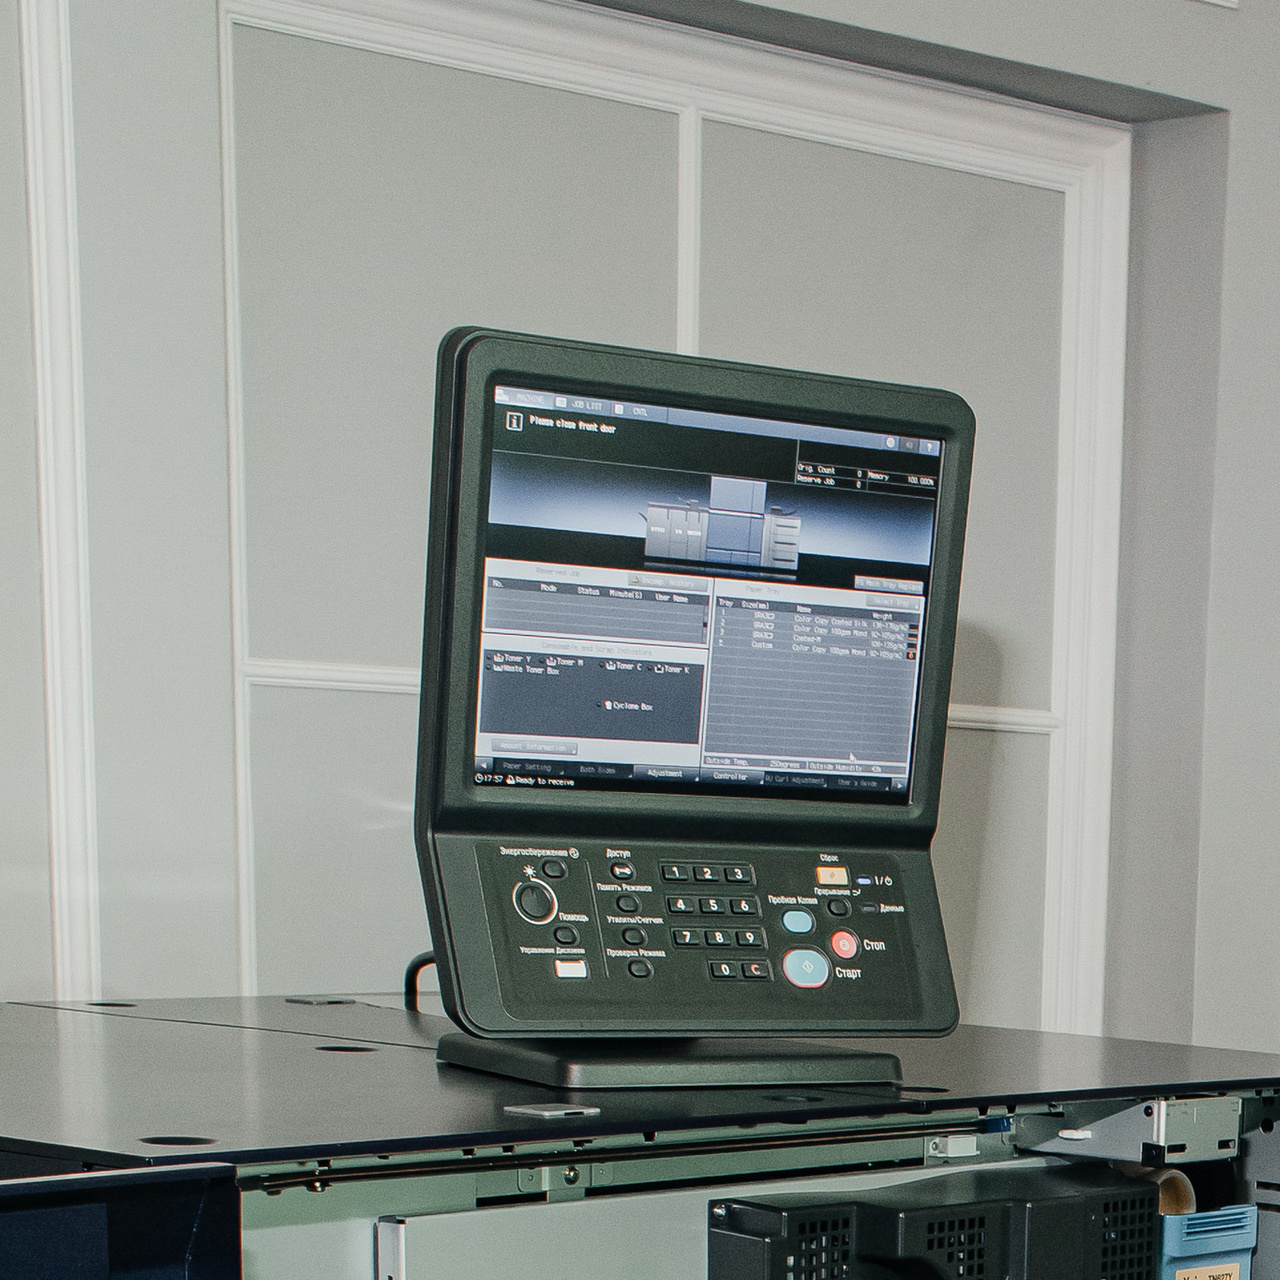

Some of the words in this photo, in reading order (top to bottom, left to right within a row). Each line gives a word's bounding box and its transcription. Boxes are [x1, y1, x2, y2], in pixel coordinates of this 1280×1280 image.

[572, 400, 584, 409] JOB
[586, 402, 602, 411] LIST
[529, 414, 554, 427] Please
[555, 418, 577, 430] close
[578, 420, 599, 432] front
[600, 423, 617, 434] door
[798, 463, 814, 473] Orig.
[817, 465, 835, 475] Count
[867, 469, 889, 481] Memory
[796, 473, 821, 484] Reserve
[823, 477, 836, 486] Job
[540, 583, 557, 592] Mode
[577, 586, 600, 596] Status
[609, 589, 643, 600] Minute(S)
[655, 593, 671, 602] User
[673, 594, 689, 603] Name
[718, 598, 734, 608] Tray
[796, 605, 812, 614] Name
[872, 612, 893, 621] Weight
[794, 615, 812, 623] Color
[814, 617, 829, 626] Copy
[793, 624, 812, 632] Color
[814, 626, 828, 635] Copy
[752, 641, 773, 649] Custom
[792, 644, 810, 652] Color
[812, 645, 827, 654] Copy
[504, 653, 524, 663] Toner
[556, 657, 576, 667] Toner
[616, 661, 635, 671] Toner
[664, 664, 683, 673] Toner
[526, 666, 545, 675] Toner
[547, 667, 560, 675] Box
[613, 701, 640, 711] Cyclone
[641, 702, 654, 711] Box
[647, 769, 683, 779] Adjustment
[713, 771, 749, 782] Controller
[484, 774, 503, 783] 17:57
[515, 775, 536, 786] Ready
[537, 777, 546, 786] to
[547, 778, 575, 787] receive
[606, 848, 631, 858] Доступ
[820, 853, 839, 862] Сброс
[672, 866, 679, 878] 1
[703, 867, 712, 879] 2
[734, 868, 743, 880] 3
[676, 899, 685, 911] 4
[709, 899, 718, 911] 5
[740, 900, 749, 911] 6
[768, 895, 797, 905] Пробная
[797, 896, 818, 905] Копия
[559, 912, 589, 922] Помощь
[682, 930, 690, 942] 7
[714, 931, 724, 943] 8
[745, 931, 754, 943] 9
[863, 939, 886, 951] Стоп
[606, 948, 638, 958] Проверка
[638, 948, 666, 957] Режима
[721, 964, 730, 975] 0
[751, 964, 760, 975] C
[835, 967, 861, 979] Старт
